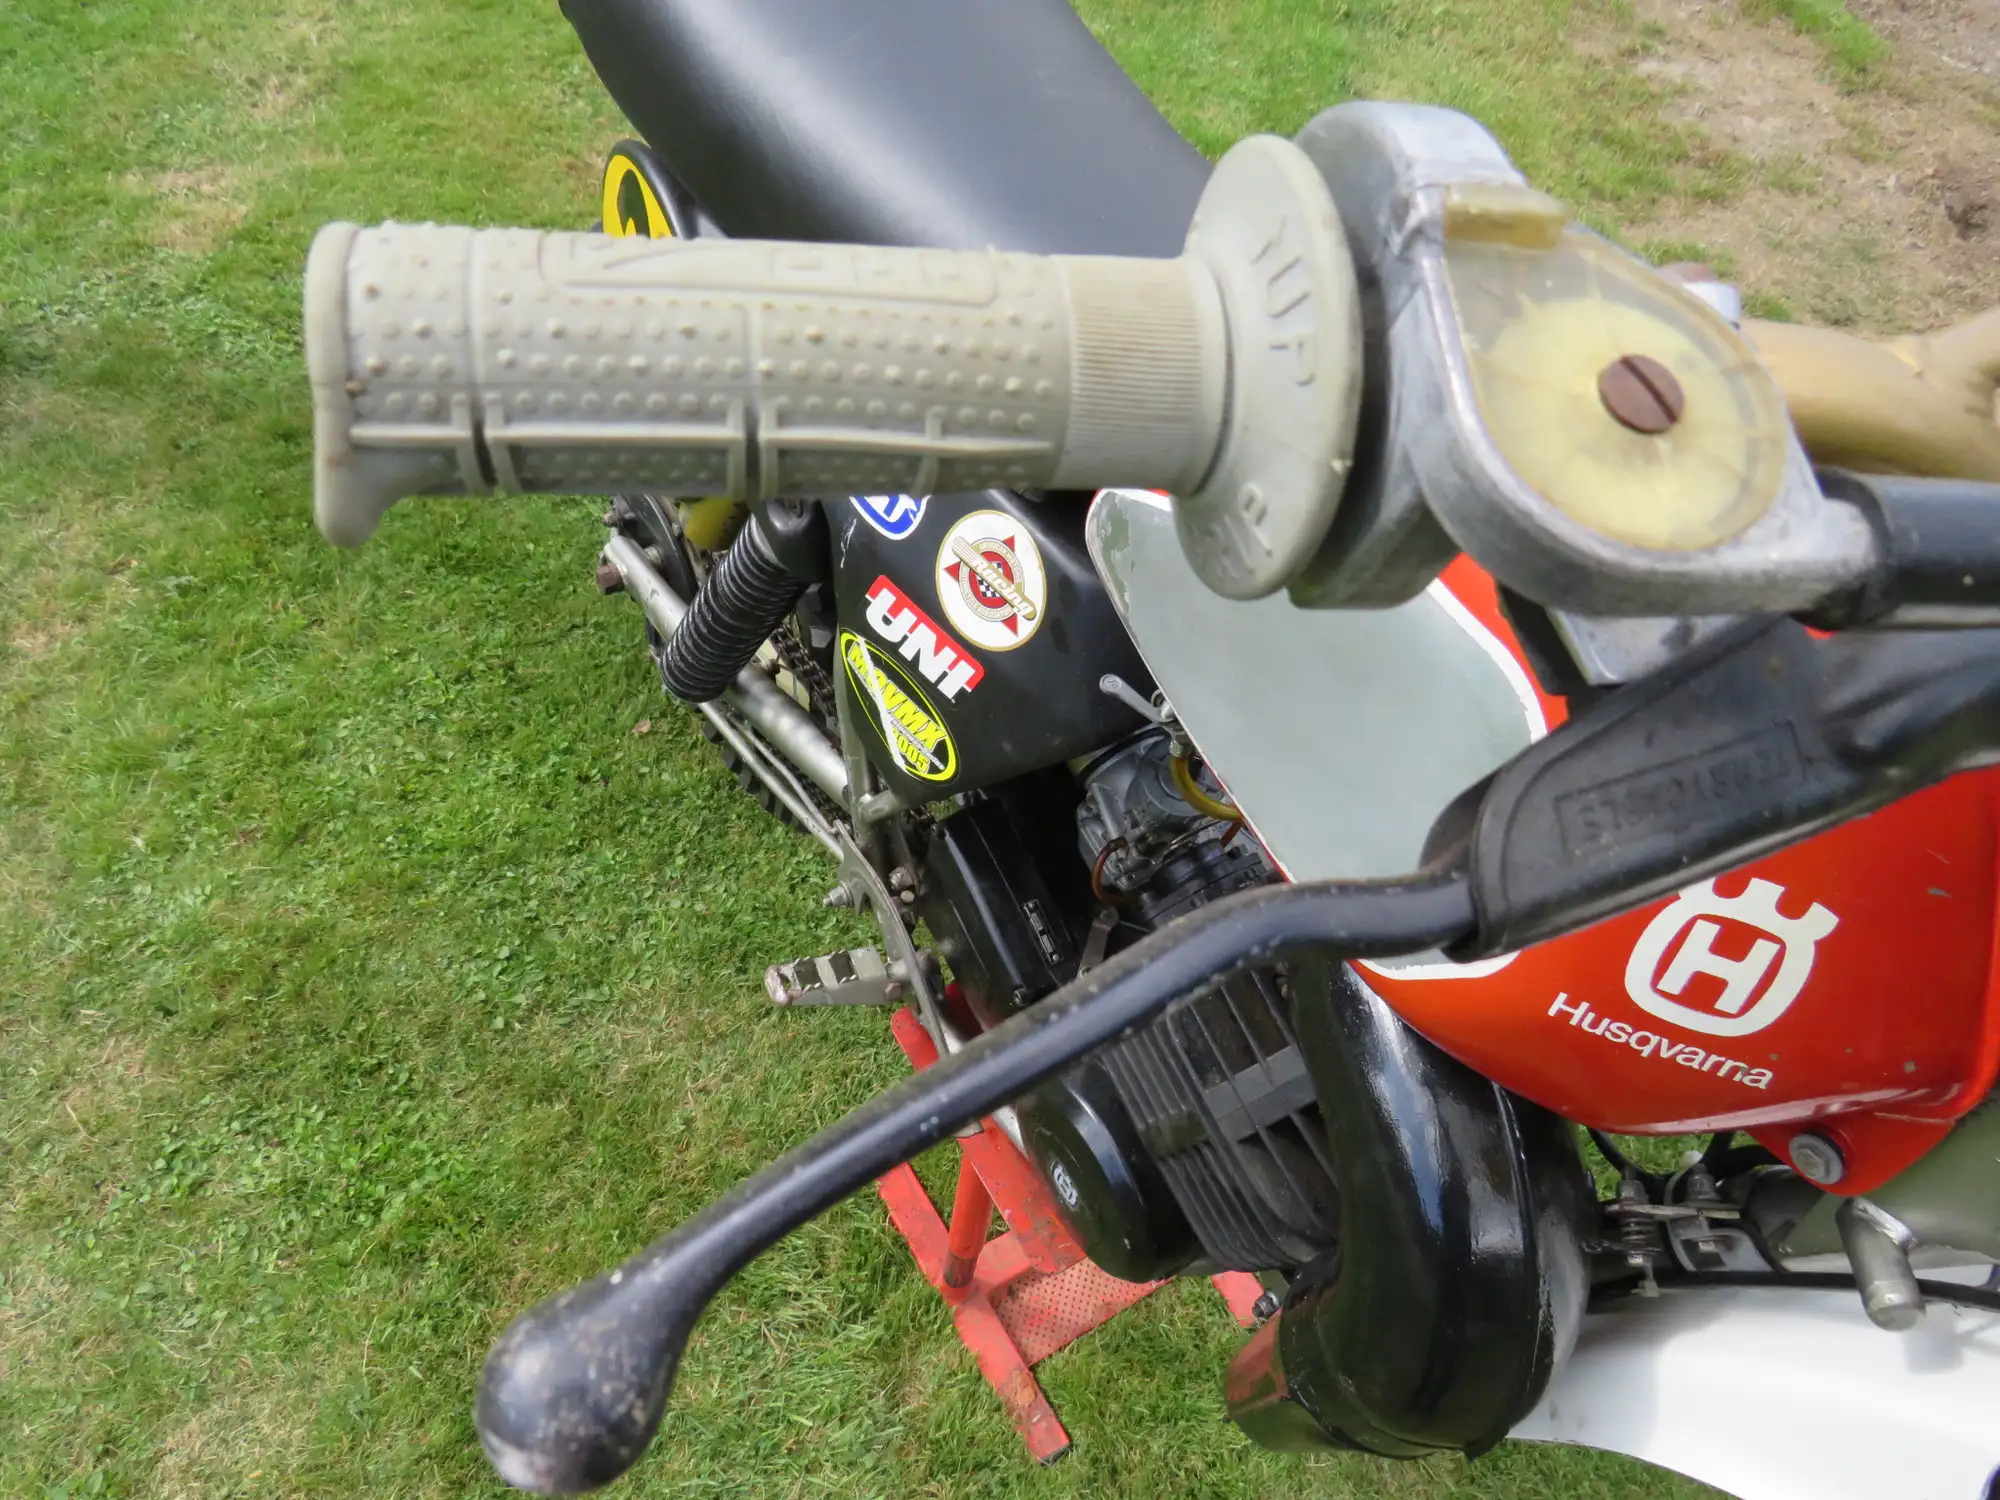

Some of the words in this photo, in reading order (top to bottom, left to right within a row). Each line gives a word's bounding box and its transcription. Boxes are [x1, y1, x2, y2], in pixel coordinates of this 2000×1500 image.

[972, 560, 1035, 617] Racing
[865, 588, 976, 699] UNI
[1547, 992, 1774, 1090] Husqvarna
